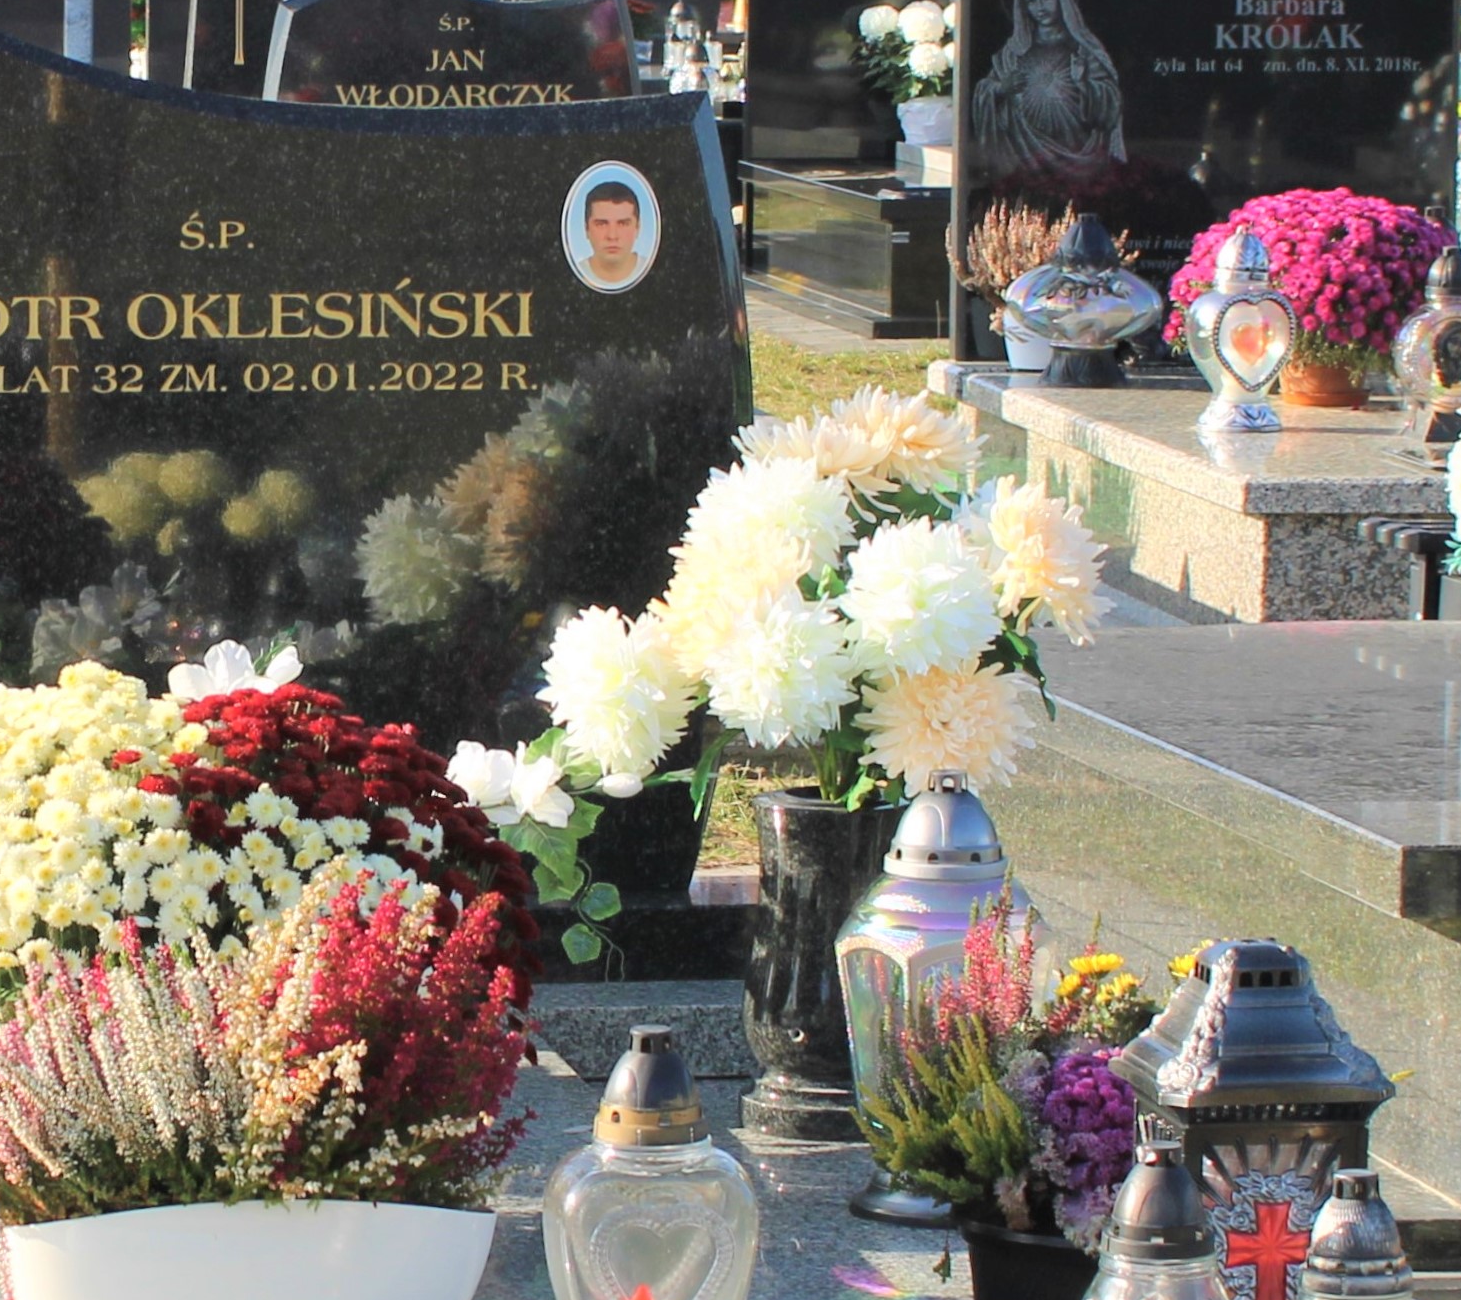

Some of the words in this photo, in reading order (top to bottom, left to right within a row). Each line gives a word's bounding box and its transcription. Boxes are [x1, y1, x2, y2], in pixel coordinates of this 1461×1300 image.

[438, 12, 475, 32] Ś.P.
[1214, 17, 1364, 51] KRÓLAK
[425, 48, 485, 72] JAN
[1152, 58, 1187, 77] żyła
[1195, 57, 1217, 73] lat
[1223, 58, 1244, 73] 64
[1262, 60, 1292, 73] zm.
[1295, 57, 1322, 73] dn.
[1325, 58, 1341, 73] 8.
[1344, 57, 1371, 73] XI.
[335, 83, 575, 109] WŁODARCZYK
[179, 211, 255, 251] Ś.P.
[126, 277, 535, 341] OKLESIŃSKI
[93, 364, 144, 394] 32
[158, 363, 230, 395] ZM.
[242, 362, 485, 394] 02.01.2022
[500, 362, 540, 393] R.
